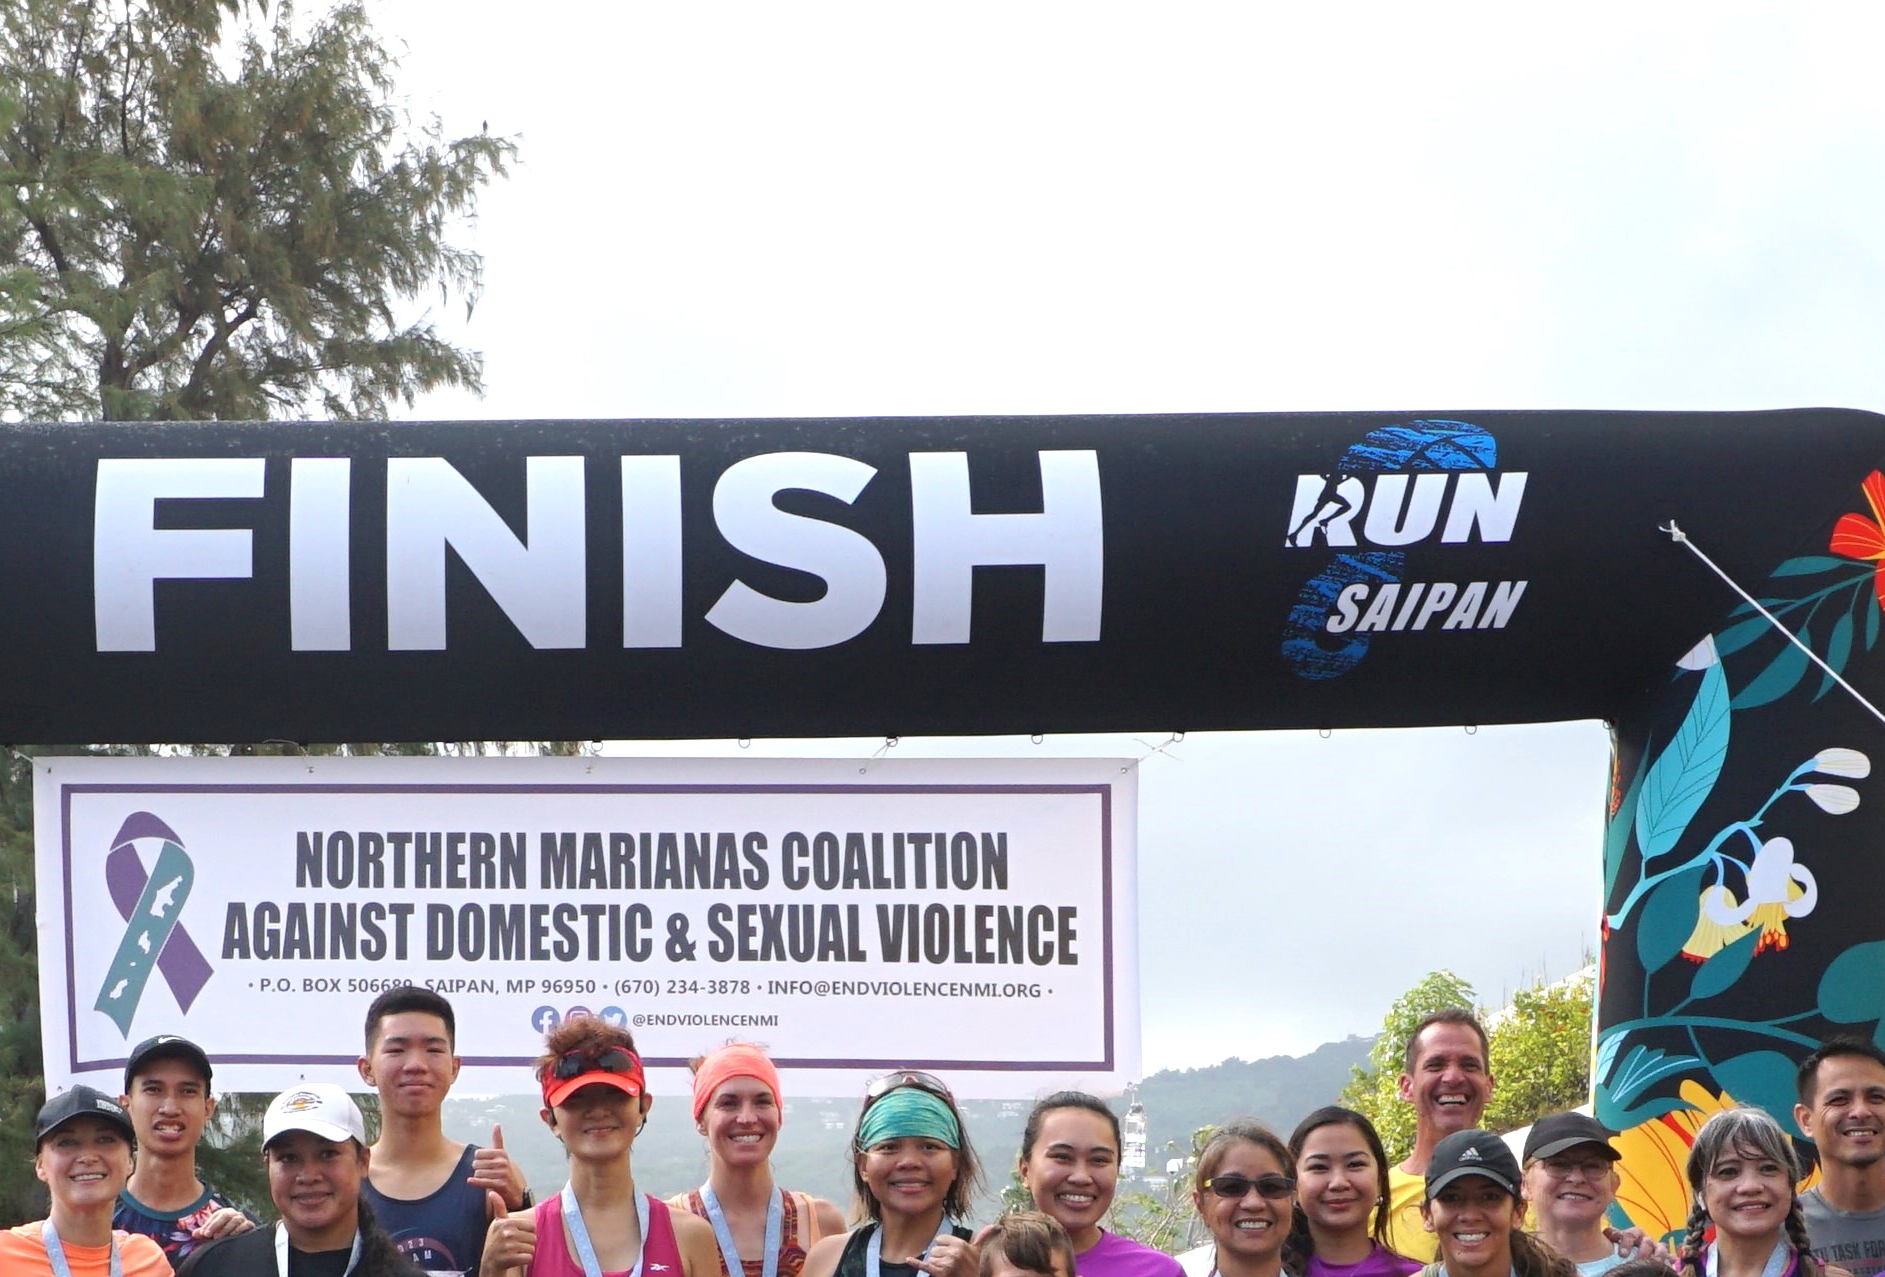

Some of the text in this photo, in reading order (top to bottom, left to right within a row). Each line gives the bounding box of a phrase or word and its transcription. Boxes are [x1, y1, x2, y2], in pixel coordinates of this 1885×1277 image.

[1285, 472, 1528, 548] RUN
[94, 449, 1104, 653] FINISH
[1327, 580, 1528, 634] SAIPAN
[296, 831, 1008, 891] NORTHERN MARIANAS COALITION
[221, 901, 1078, 966] AGAINST DOMESTIC & SEXUAL VIOLENCE
[260, 978, 296, 994] P.O.
[303, 978, 341, 994] BOX
[424, 978, 499, 996] SAIPAN,
[506, 979, 535, 994] MP
[542, 979, 596, 994] 96950
[614, 979, 660, 997] (670)
[667, 980, 750, 995] 234-3878
[768, 980, 1041, 998] INFO@ENDVIOLENCENMI.ORG
[632, 1013, 779, 1028] @ENDVIOLENCENMI
[1831, 1242, 1861, 1262] TASK
